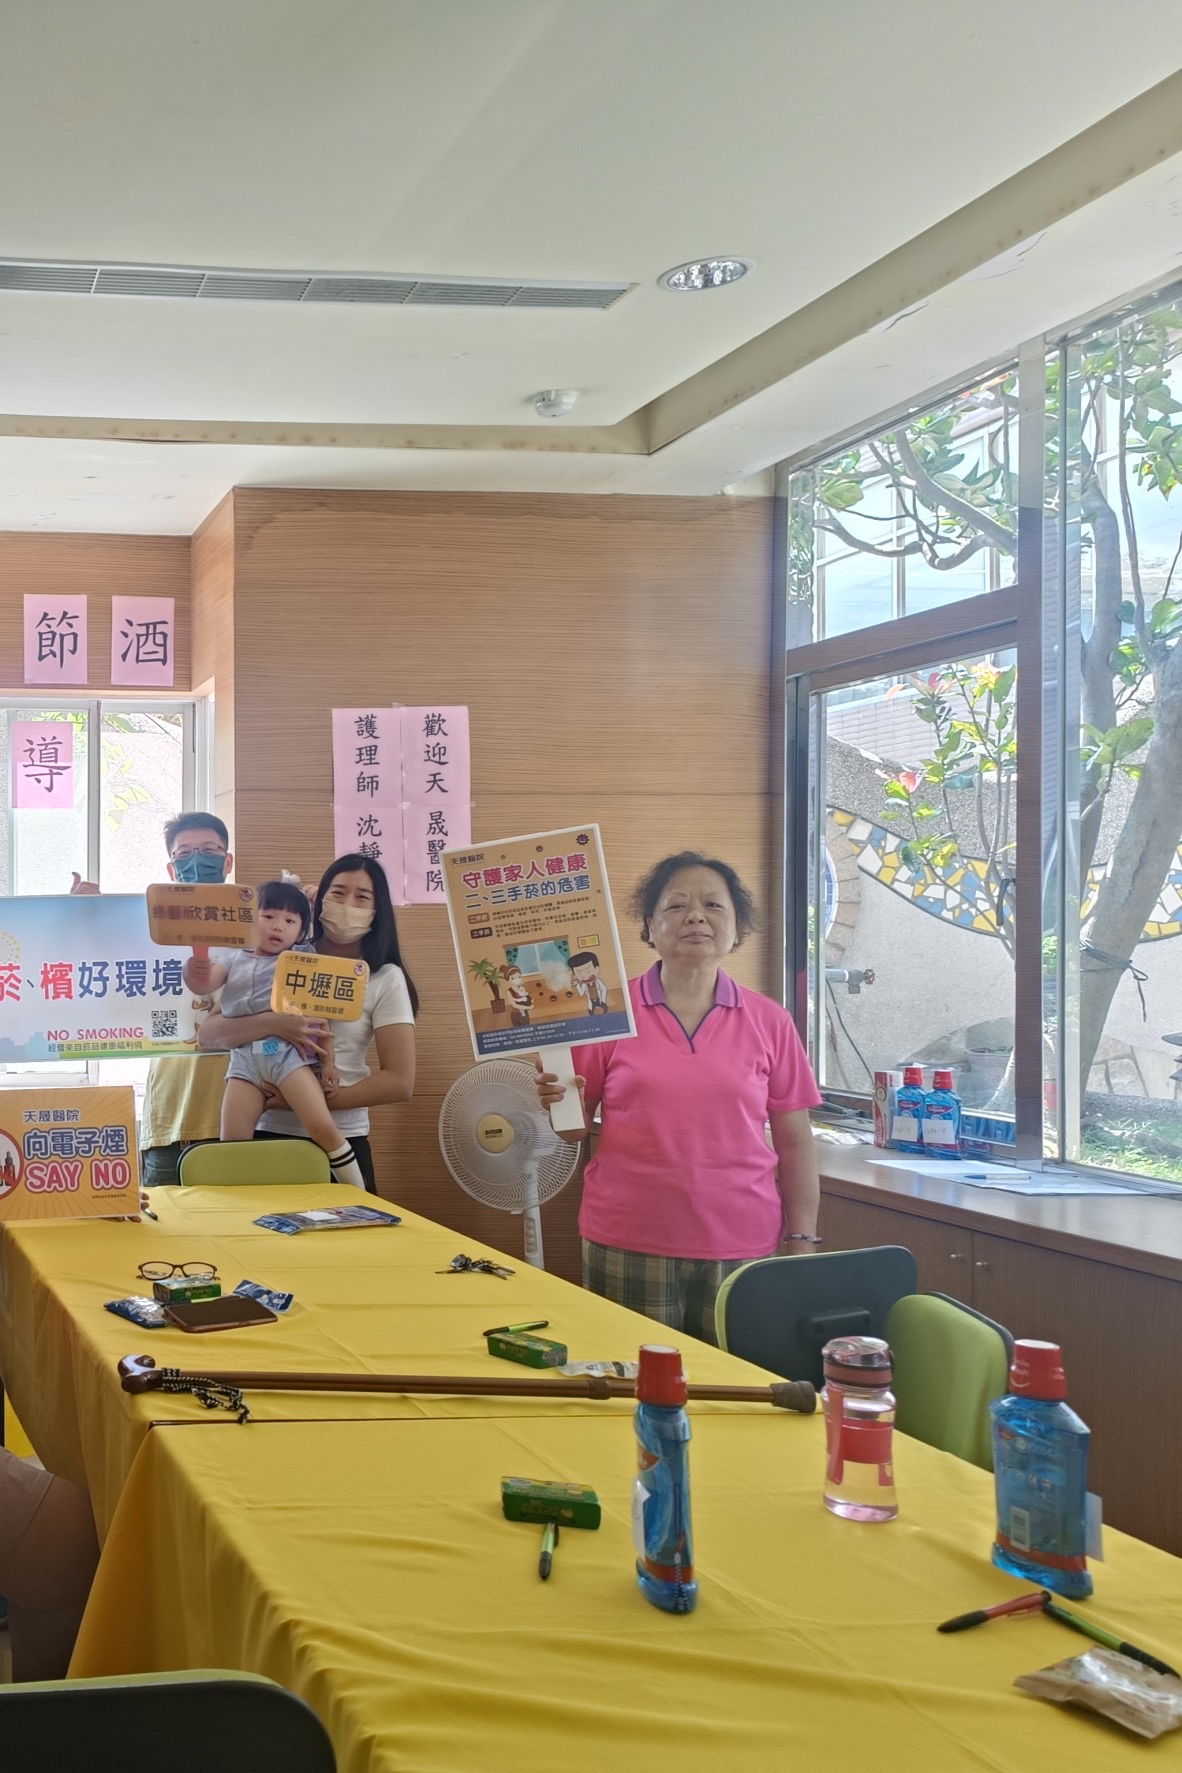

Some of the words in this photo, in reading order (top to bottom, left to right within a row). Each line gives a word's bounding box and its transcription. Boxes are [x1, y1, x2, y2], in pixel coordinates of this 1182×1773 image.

[422, 712, 449, 892] 歡迎天晟醫院
[450, 853, 485, 867] 天晟醫院
[461, 853, 588, 891] 守護家人健康
[465, 874, 591, 909] 二、三手菸的危害
[285, 969, 358, 1002] 中壢區
[47, 1029, 70, 1041] NO
[77, 1027, 144, 1040] SMOKING
[23, 1109, 81, 1123] 天晟醫院
[24, 1126, 127, 1159] 向電子煙
[25, 1161, 82, 1193] SAY
[93, 1160, 129, 1189] NO
